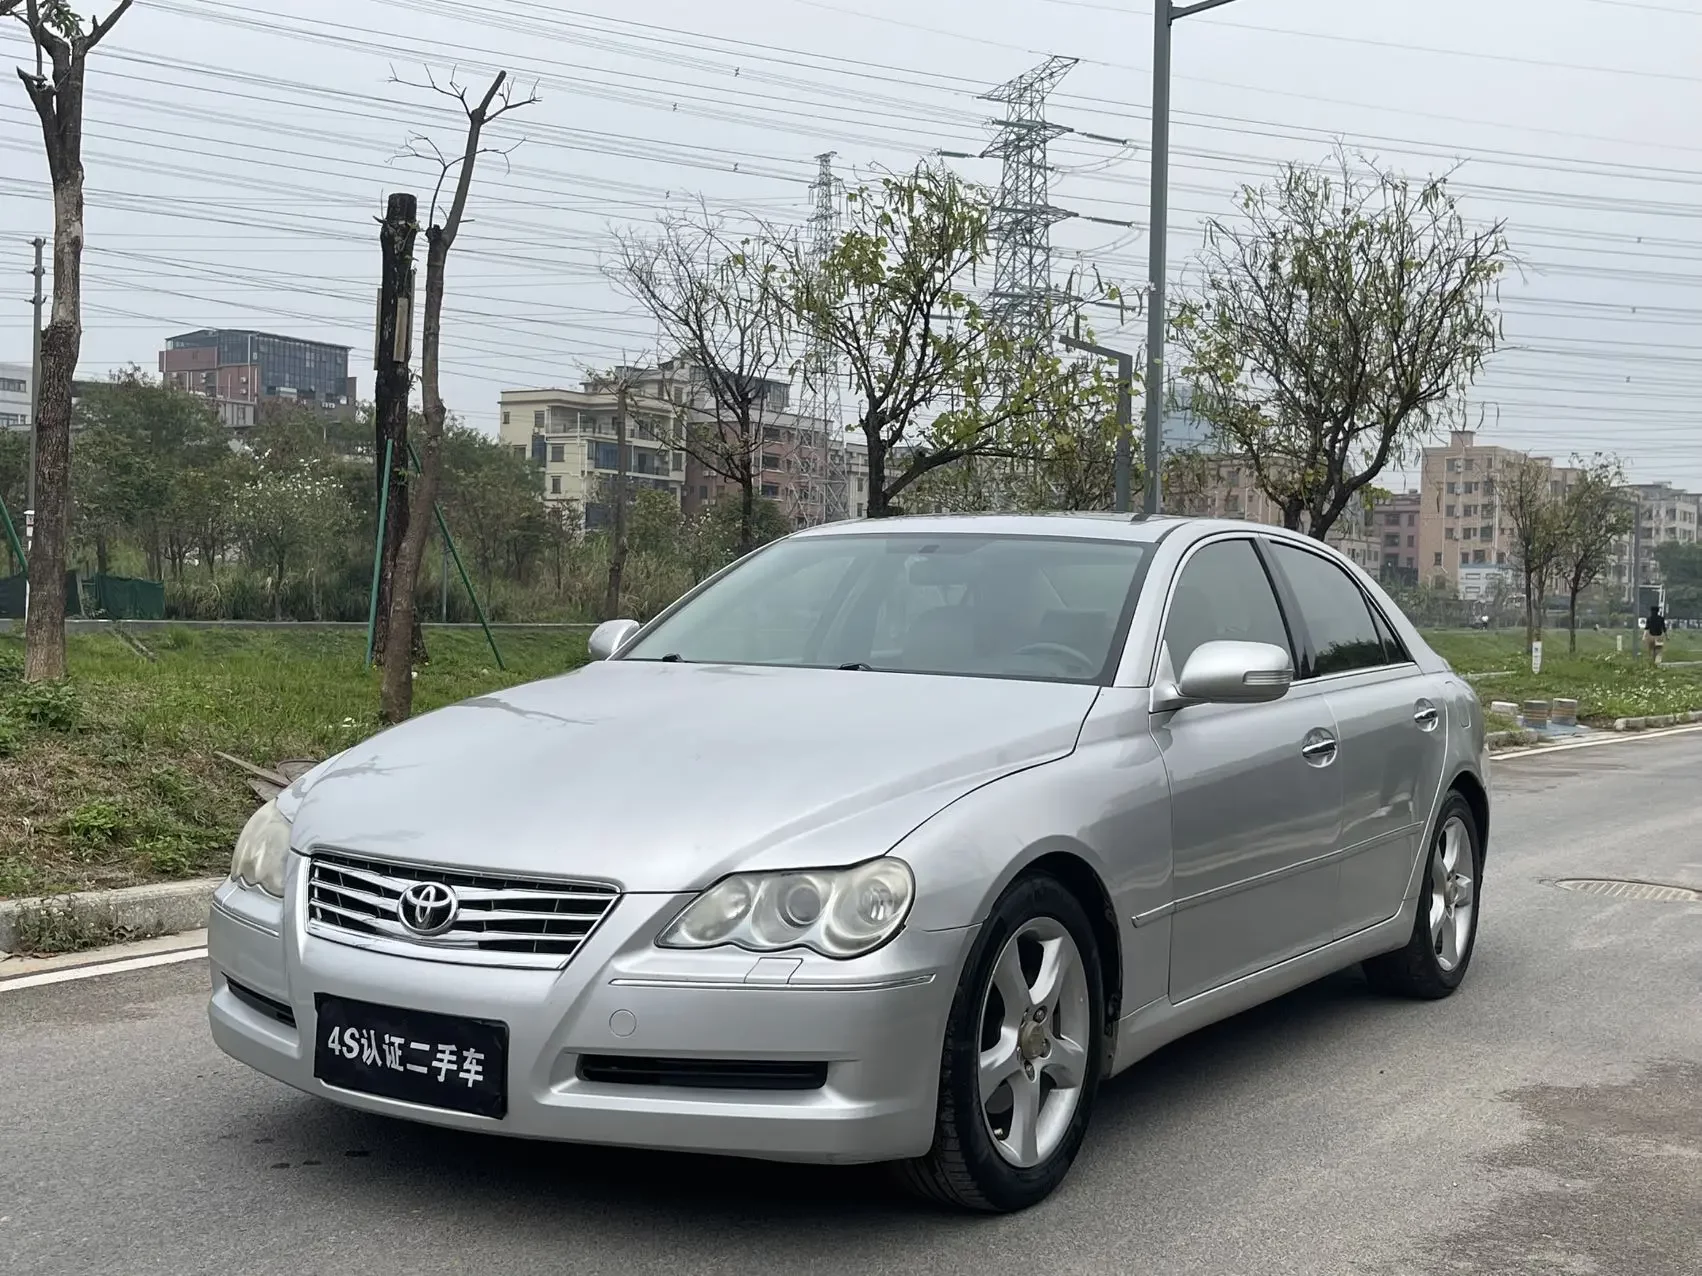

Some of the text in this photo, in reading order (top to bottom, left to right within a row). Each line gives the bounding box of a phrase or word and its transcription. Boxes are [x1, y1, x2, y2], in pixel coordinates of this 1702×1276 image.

[327, 1026, 485, 1088] 4S认证二手车
